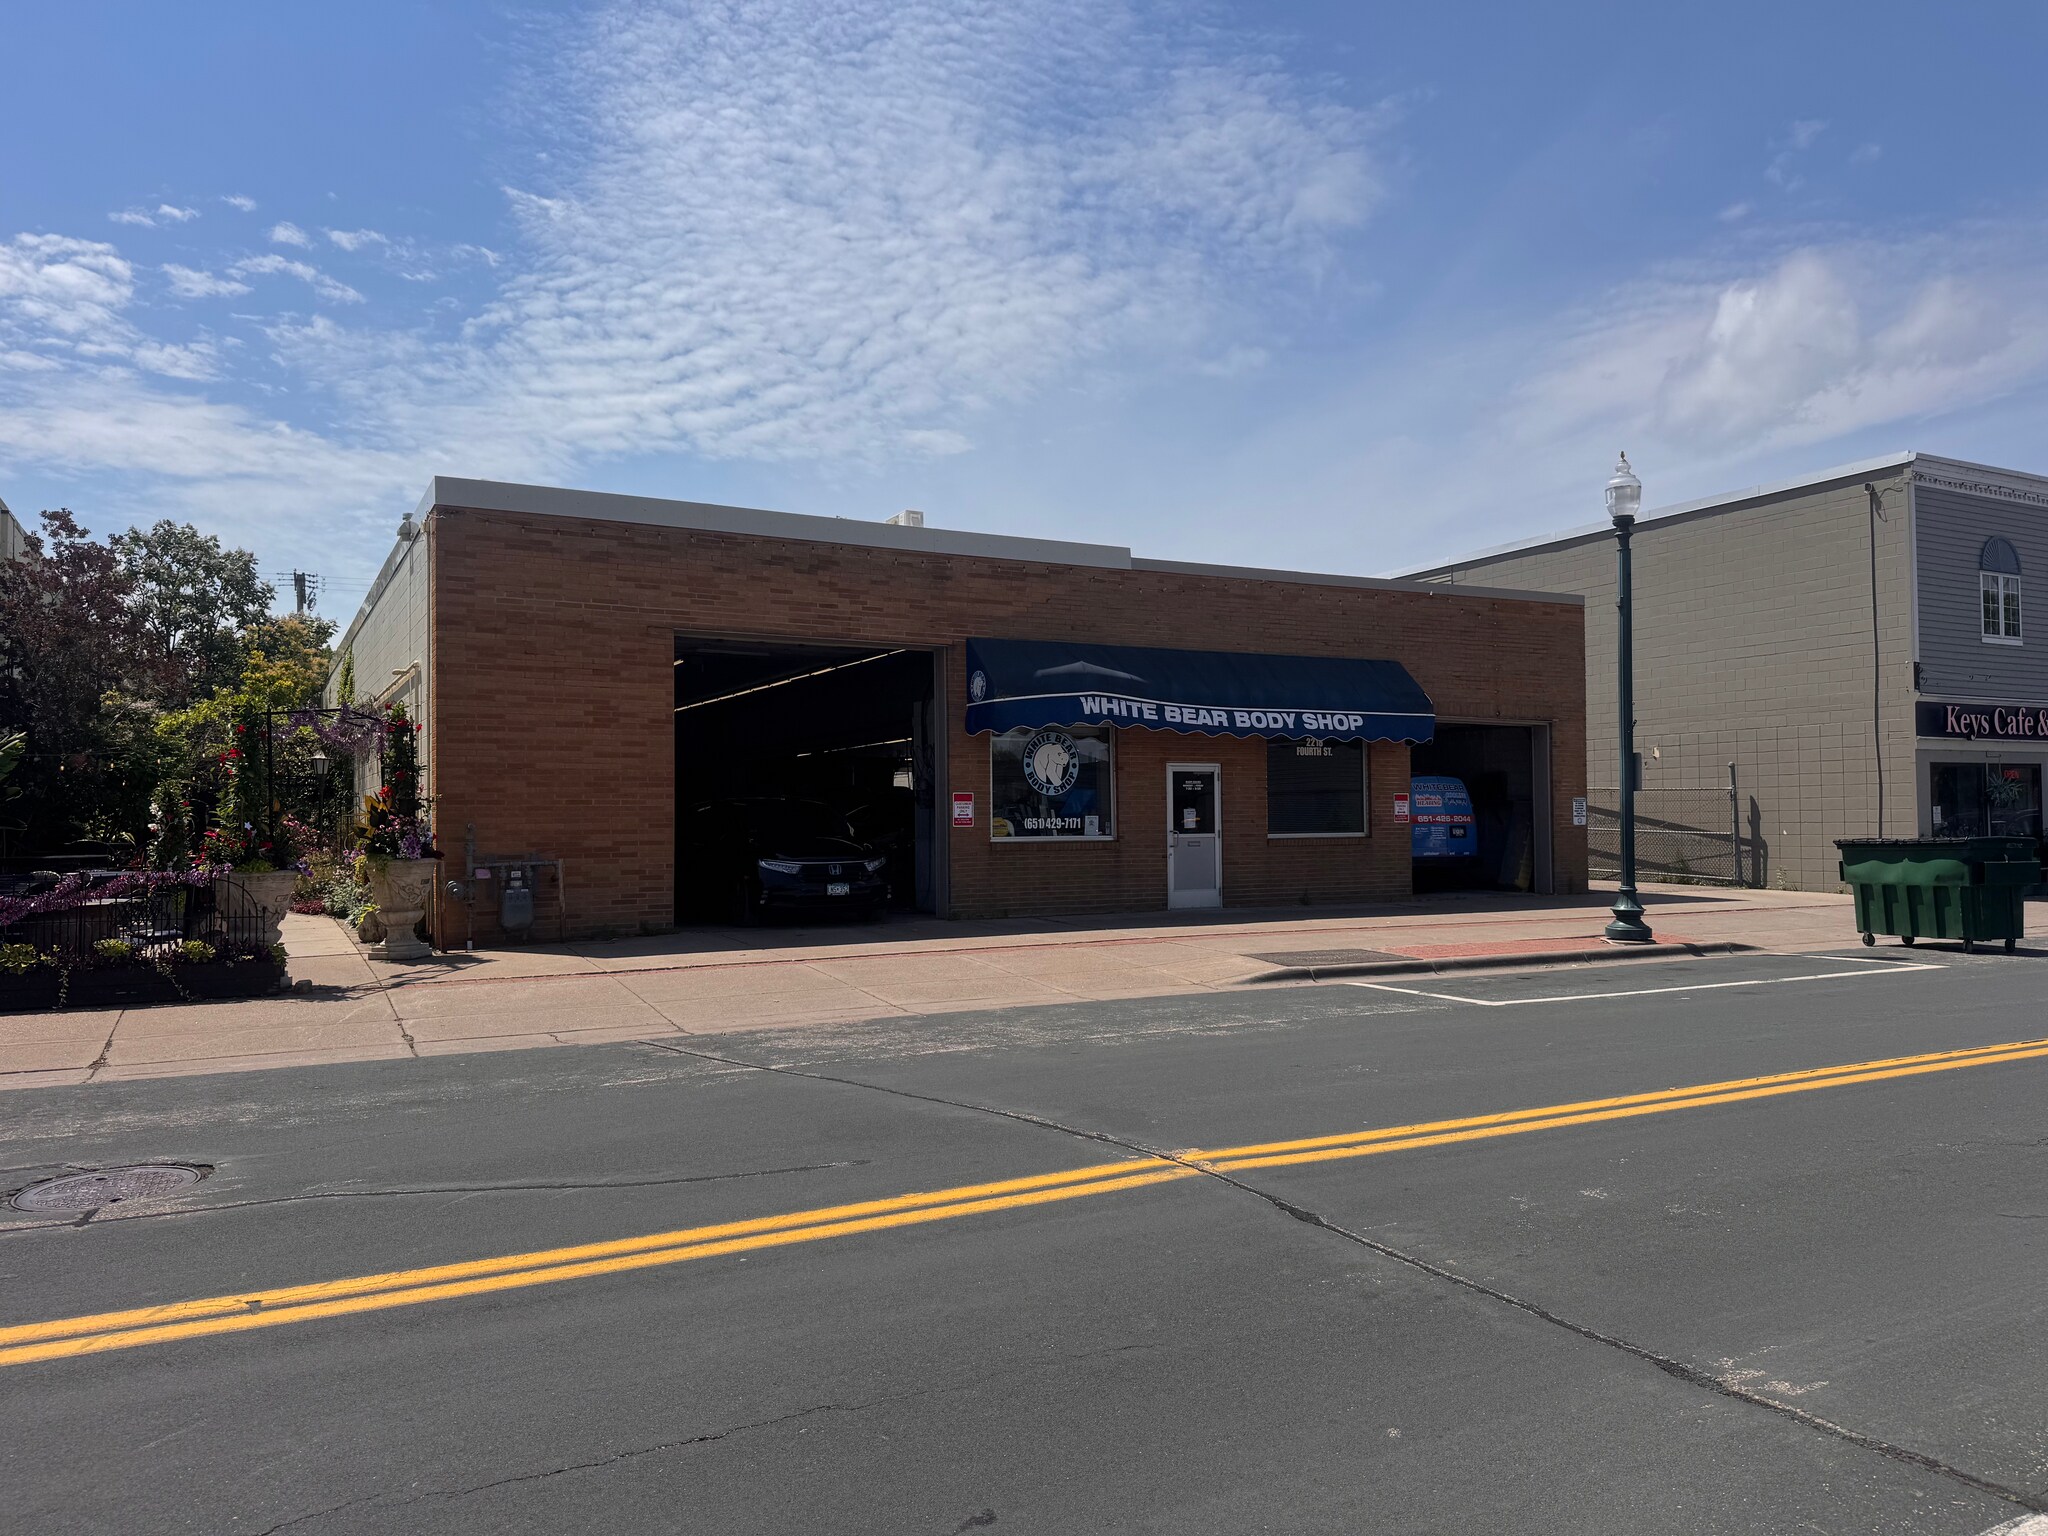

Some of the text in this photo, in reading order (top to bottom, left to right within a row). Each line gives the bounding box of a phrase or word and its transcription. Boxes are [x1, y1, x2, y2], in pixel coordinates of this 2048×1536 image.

[1080, 696, 1364, 731] WHITE BEAR BODY SHOP
[1946, 705, 1990, 741] Keys
[1994, 707, 2034, 736] Cafe
[1025, 733, 1077, 760] WHITE BEAR
[1296, 747, 1333, 756] FOURTH ST.
[1027, 771, 1075, 794] BODY SHOP
